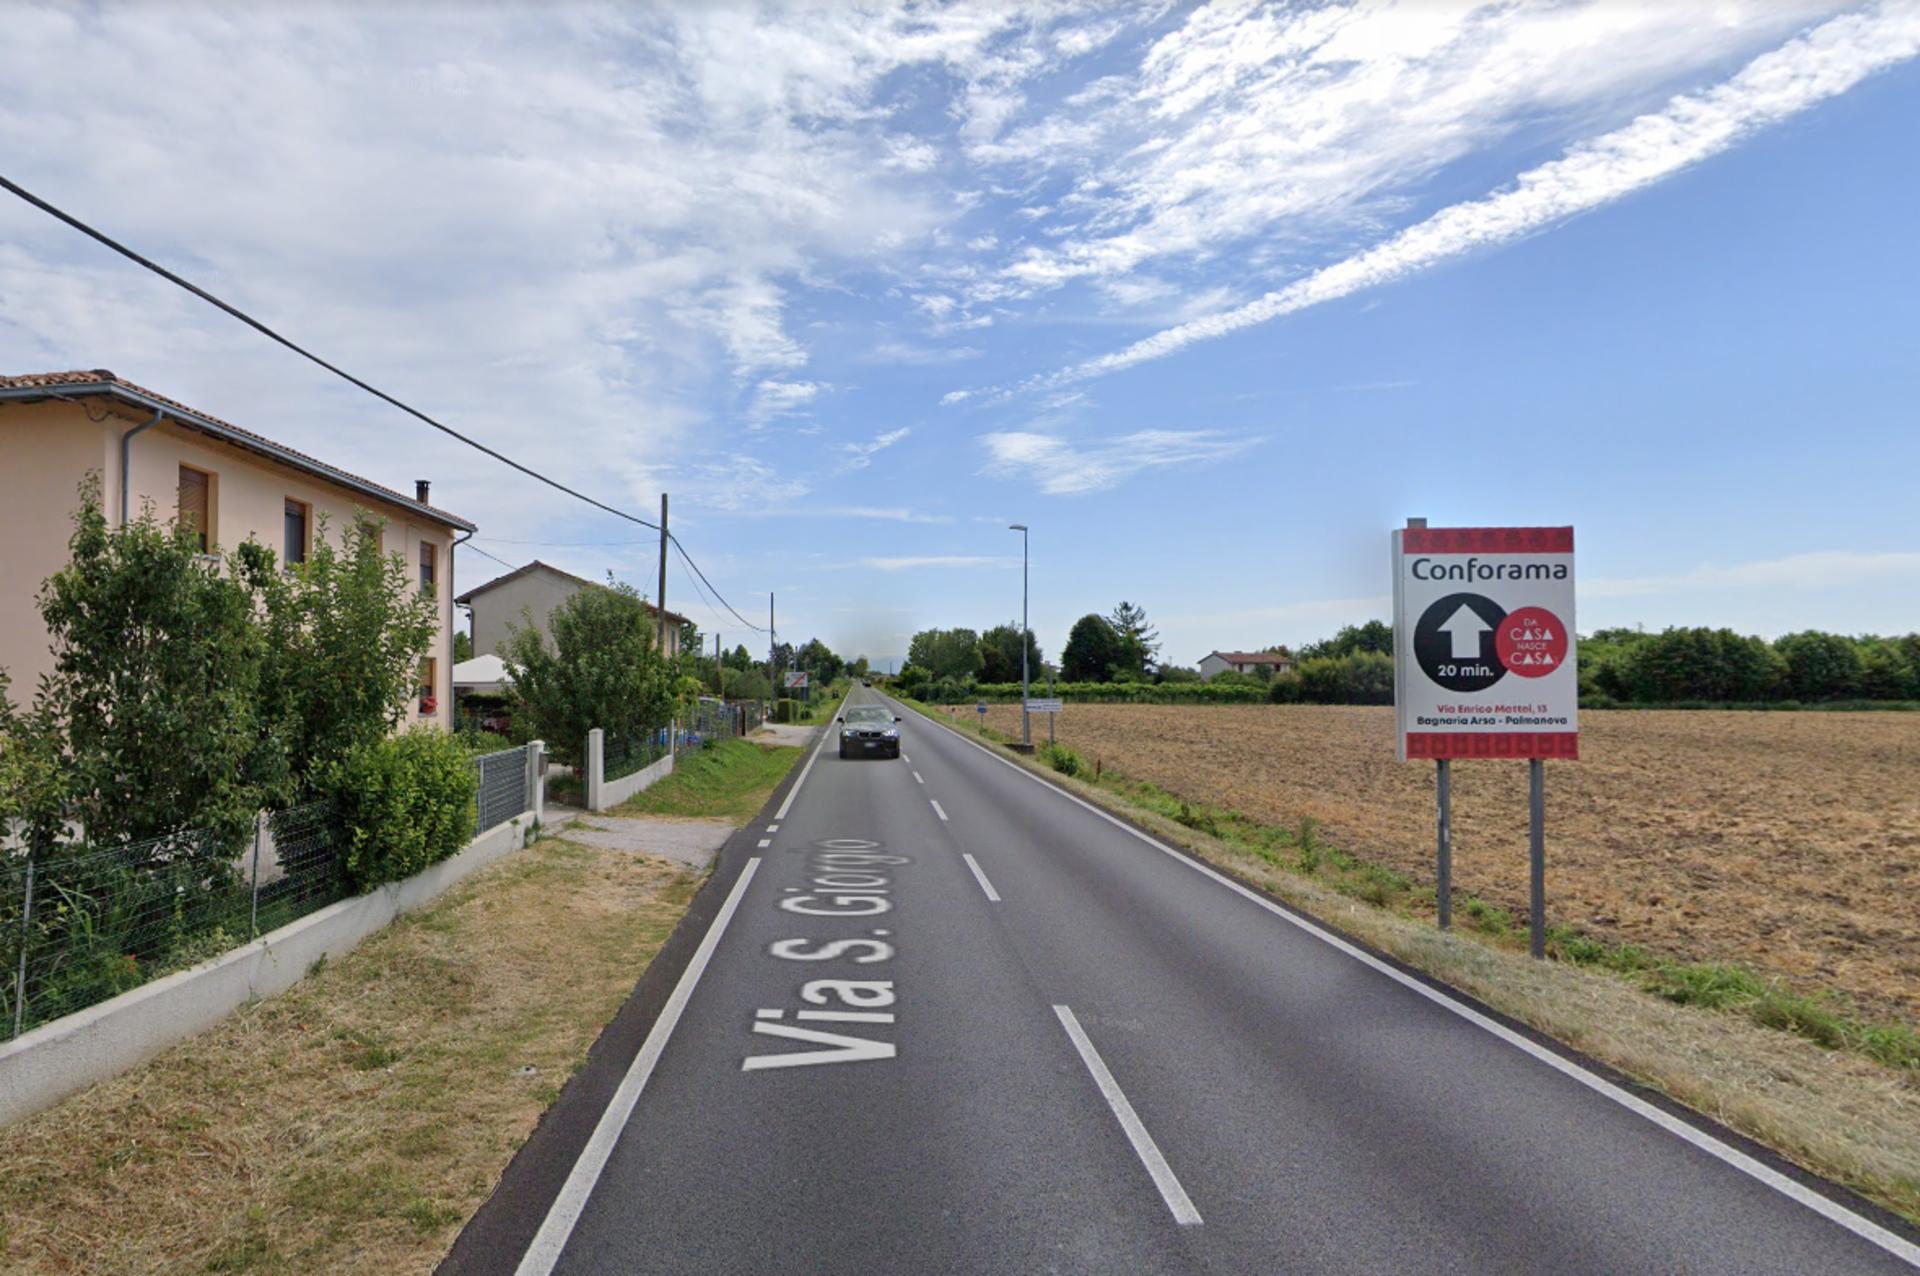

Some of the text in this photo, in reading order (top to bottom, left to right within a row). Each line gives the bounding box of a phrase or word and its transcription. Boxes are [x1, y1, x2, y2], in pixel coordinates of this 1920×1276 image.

[1412, 558, 1568, 582] Conforama
[1510, 627, 1553, 640] CASA
[1510, 652, 1553, 665] CASA
[1438, 664, 1494, 676] 20 min.
[1437, 704, 1455, 714] Via
[1458, 704, 1492, 714] Enrico
[1537, 704, 1548, 714] 13
[1417, 716, 1468, 726] Bagnaria
[1470, 716, 1496, 725] Arsa
[1505, 715, 1568, 725] Palmanova
